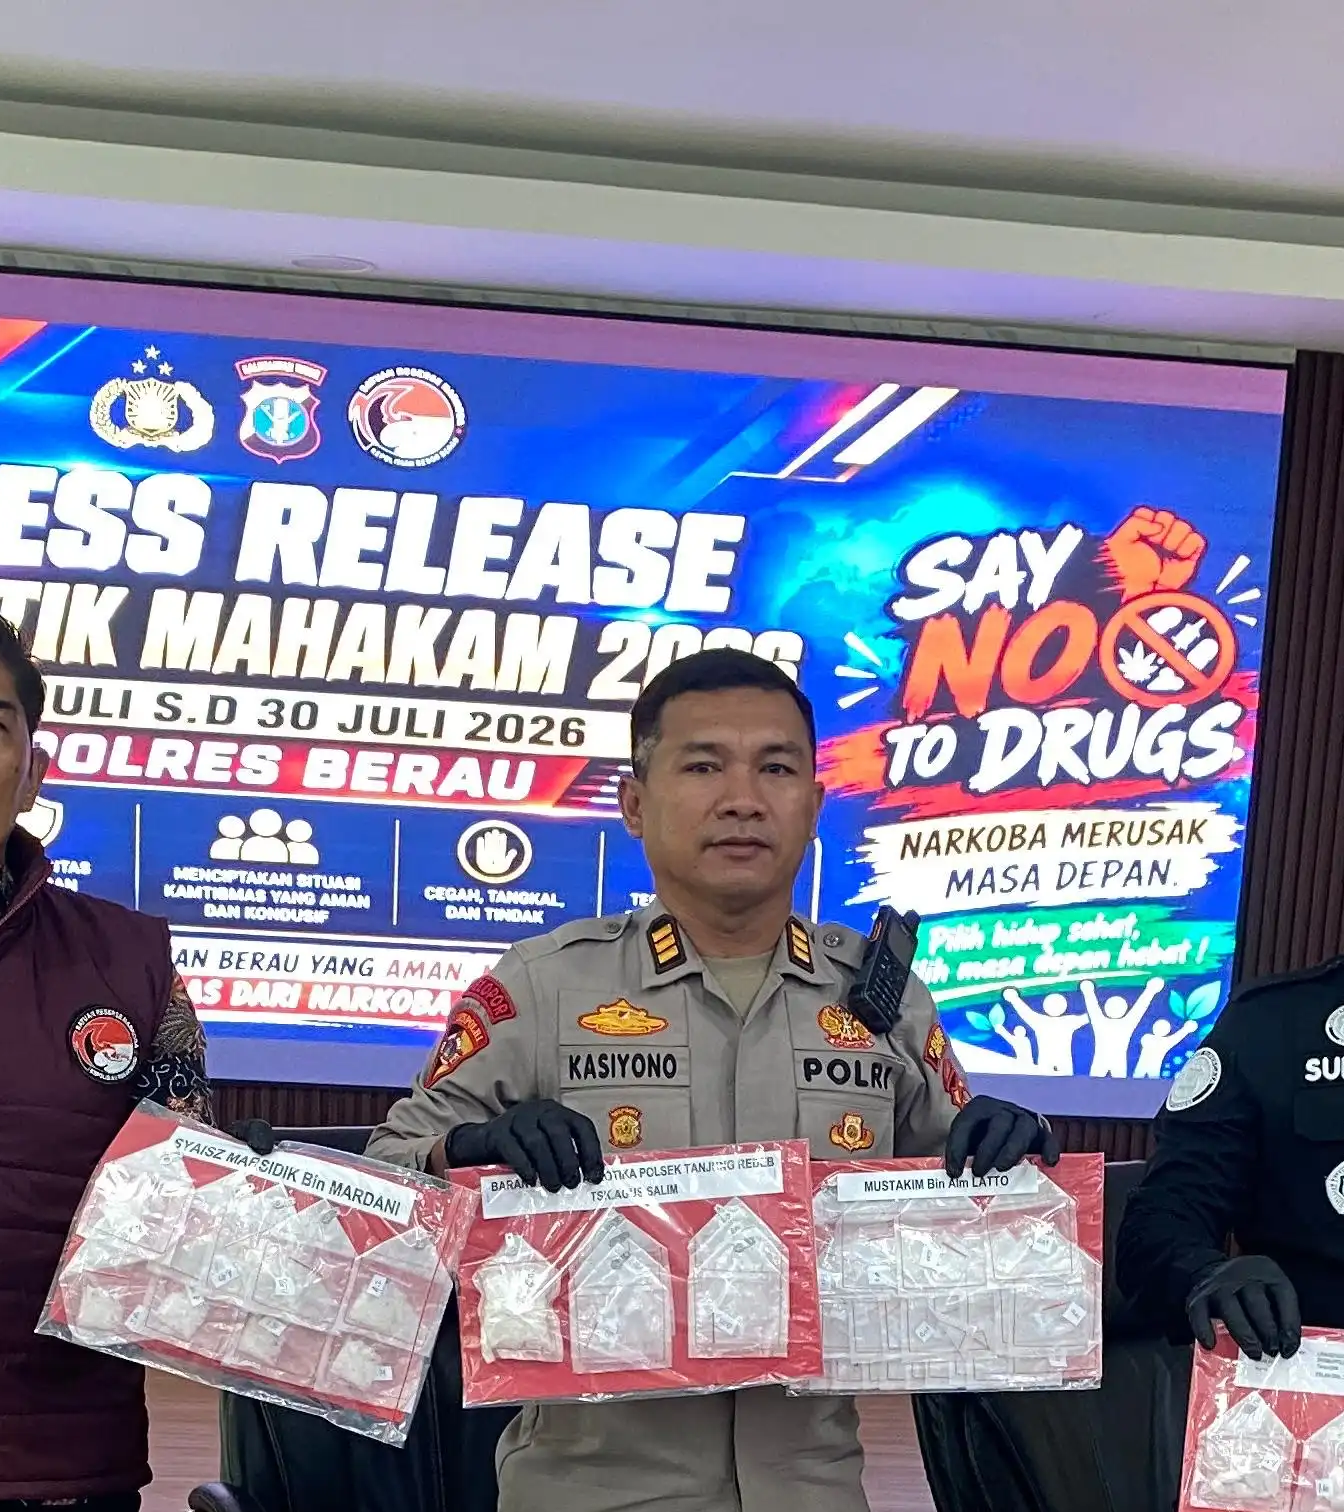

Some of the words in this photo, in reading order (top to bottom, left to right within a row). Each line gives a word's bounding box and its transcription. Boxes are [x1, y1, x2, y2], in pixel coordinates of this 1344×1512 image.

[234, 481, 745, 613] RELEASE
[892, 522, 1084, 620] SAY
[140, 589, 579, 697] MAHAKAM
[903, 600, 1098, 723] NO
[49, 683, 131, 720] ULI
[154, 690, 238, 726] S.D
[257, 697, 319, 732] 30
[338, 704, 446, 740] JULI
[465, 712, 587, 748] 2026
[887, 723, 957, 787] TO
[302, 747, 538, 801] BERAU
[899, 822, 1047, 861] NARKOBA
[1059, 817, 1208, 849] MERUSAK
[163, 883, 267, 905] KAMTIBMAS
[269, 889, 317, 908] YANG
[318, 893, 371, 910] AMAN
[173, 866, 293, 889] MENCIPTAKAN
[296, 873, 362, 891] SITUASI
[944, 862, 1041, 899] MASA
[1055, 858, 1178, 891] DEPAN.
[204, 902, 246, 920] DAN
[249, 905, 330, 925] KONDUSIF
[445, 905, 481, 921] DAN
[484, 907, 545, 925] TINDAK
[992, 917, 1062, 952] hidup
[219, 950, 300, 973] BERAU
[311, 954, 375, 978] YANG
[229, 979, 303, 1010] DARI
[307, 984, 453, 1017] NARKOBA
[568, 1051, 678, 1082] KASIYONO
[802, 1056, 894, 1092] POLRI
[637, 1163, 683, 1178] POLSEK
[864, 1178, 925, 1193] MUSTAKIM
[927, 1178, 946, 1190] Bin
[948, 1176, 970, 1189] Alm
[971, 1174, 1010, 1188] LATTO
[301, 1171, 326, 1193] Bin
[328, 1179, 402, 1217] MARDANI
[646, 1184, 679, 1197] SALIM
